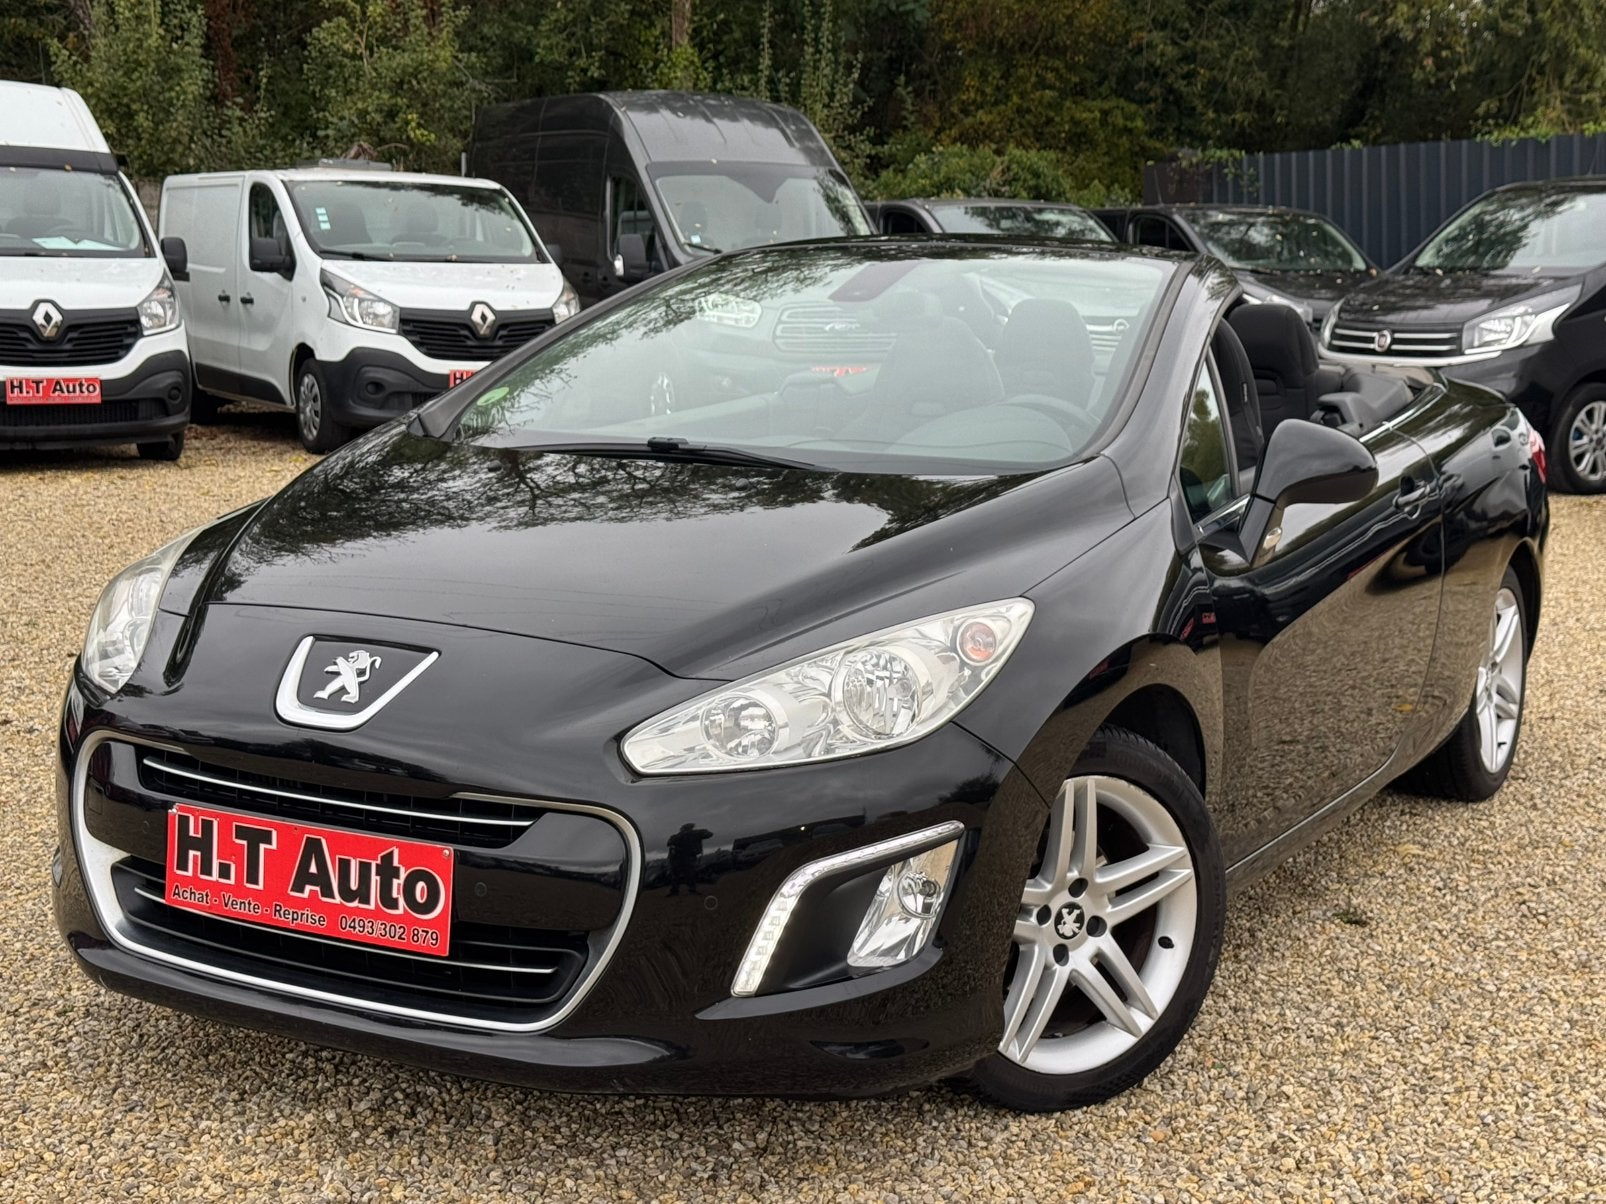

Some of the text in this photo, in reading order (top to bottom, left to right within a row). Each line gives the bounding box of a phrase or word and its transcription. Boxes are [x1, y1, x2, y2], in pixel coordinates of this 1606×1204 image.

[10, 379, 98, 395] H.T Auto
[175, 812, 445, 919] H.T Auto
[172, 884, 210, 905] Achat
[222, 893, 260, 915] Vente
[273, 903, 327, 927] Reprise
[340, 915, 406, 942] 0493/302
[411, 927, 439, 947] 879
